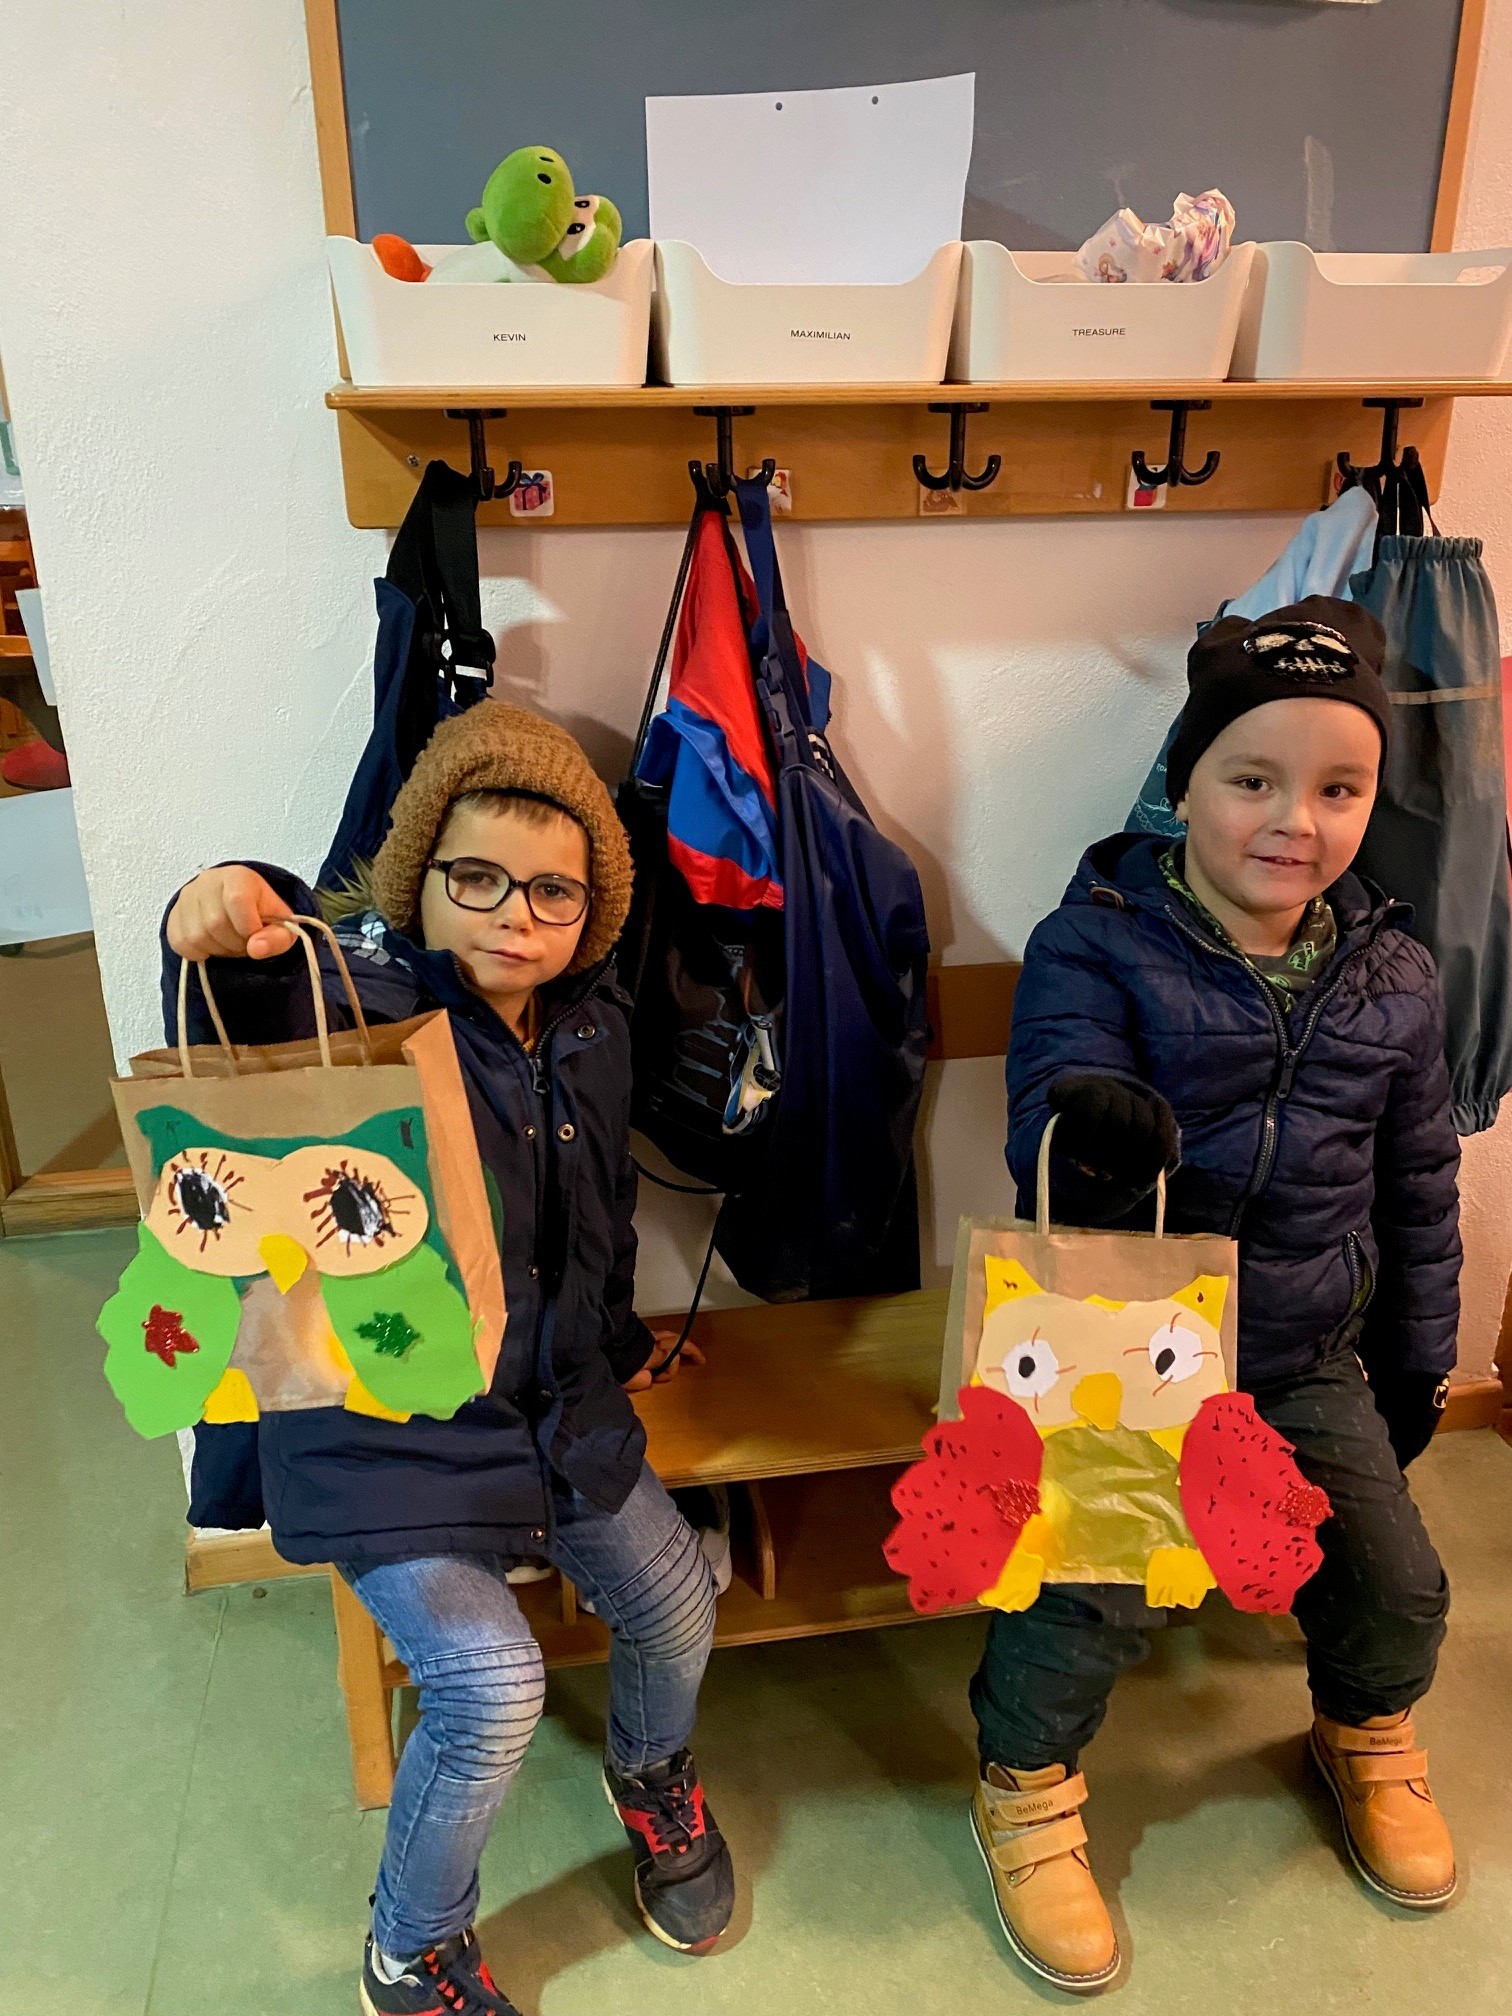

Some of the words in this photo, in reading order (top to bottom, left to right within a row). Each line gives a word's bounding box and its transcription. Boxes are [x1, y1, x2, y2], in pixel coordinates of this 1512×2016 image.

[790, 329, 851, 340] MAXIMILIAN
[1072, 327, 1126, 336] TREASURE
[493, 333, 526, 341] KEVIN
[1016, 1800, 1054, 1815] BeMega
